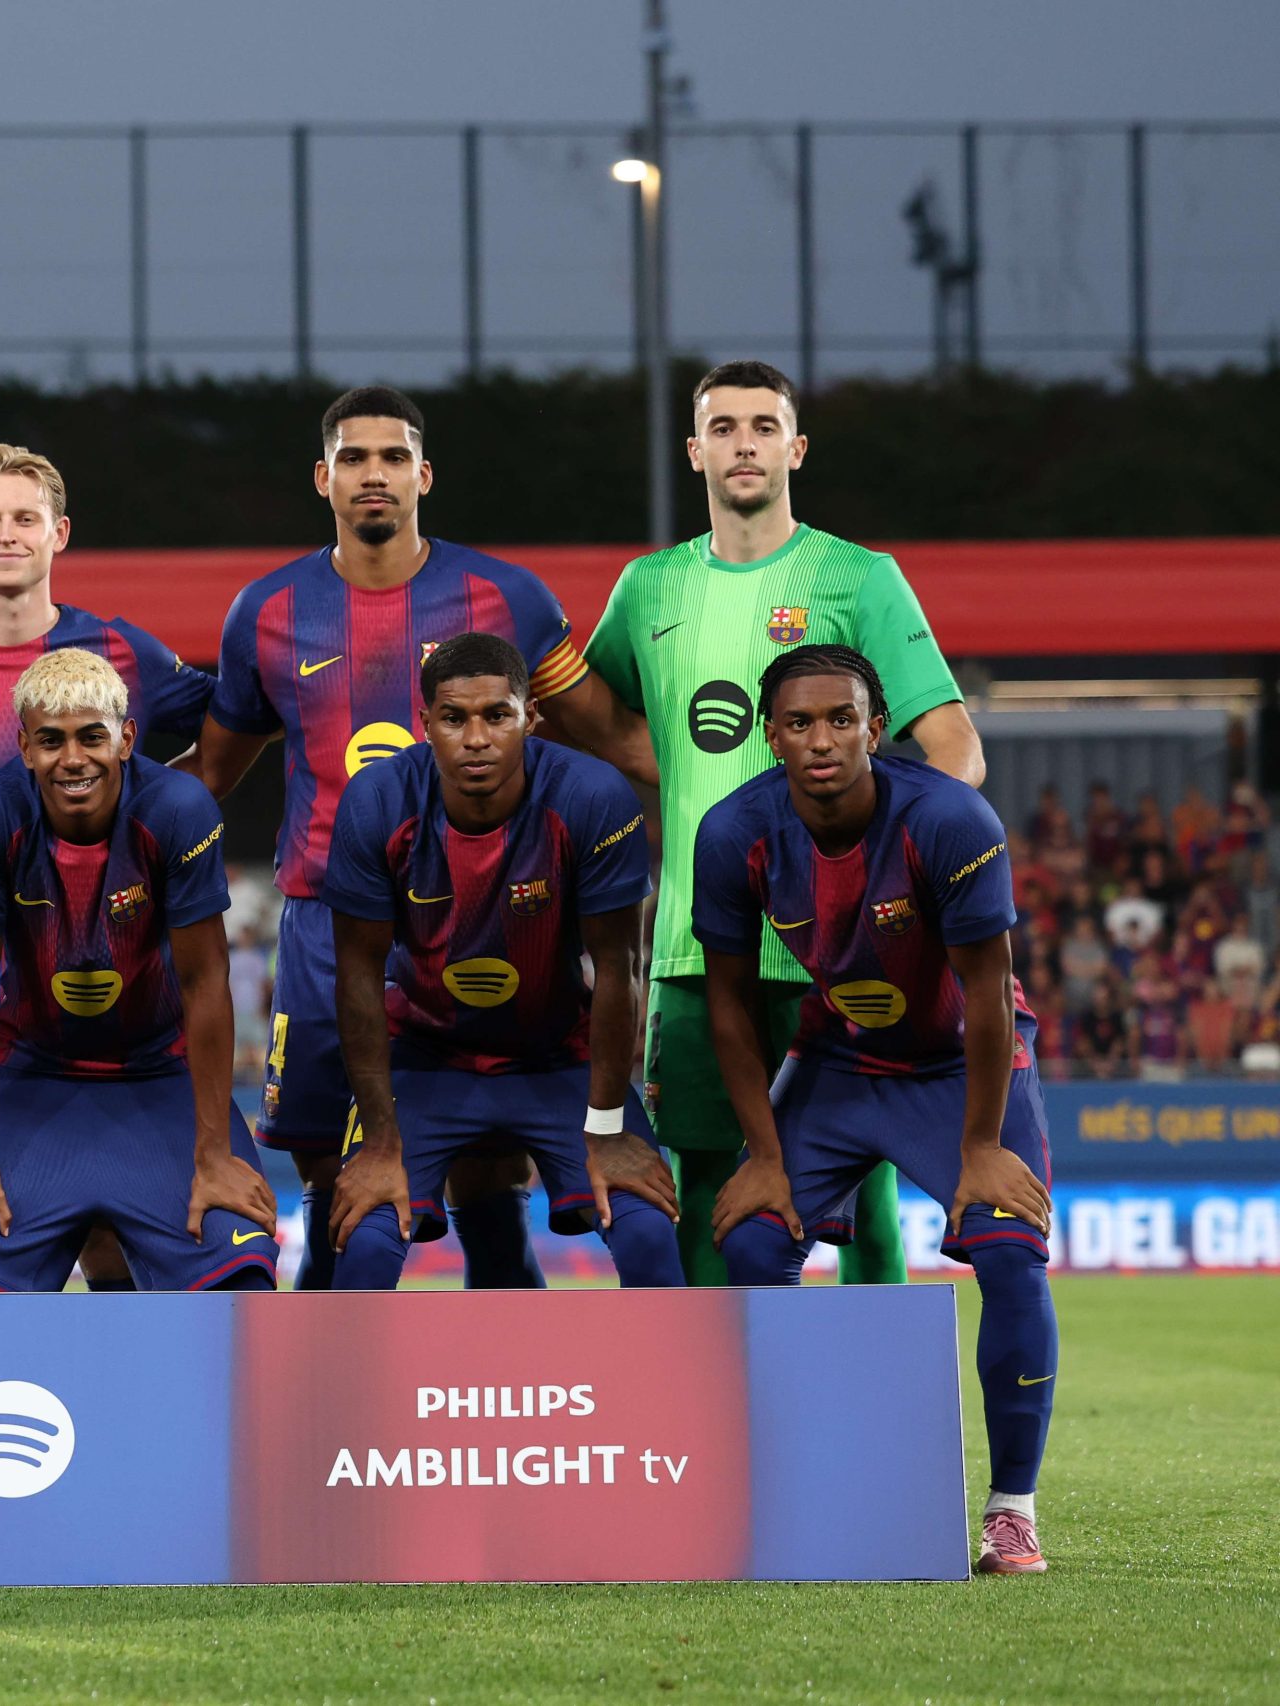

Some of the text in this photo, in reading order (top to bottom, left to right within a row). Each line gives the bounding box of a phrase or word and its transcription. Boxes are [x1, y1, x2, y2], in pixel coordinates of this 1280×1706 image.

[594, 815, 640, 854] AMBILIGHT
[949, 846, 998, 884] AMBILIGHT
[1158, 1105, 1225, 1146] QUE
[1070, 1197, 1186, 1270] DEL
[416, 1384, 596, 1419] PHILIPS
[325, 1445, 689, 1488] AMBILIGHT tv
